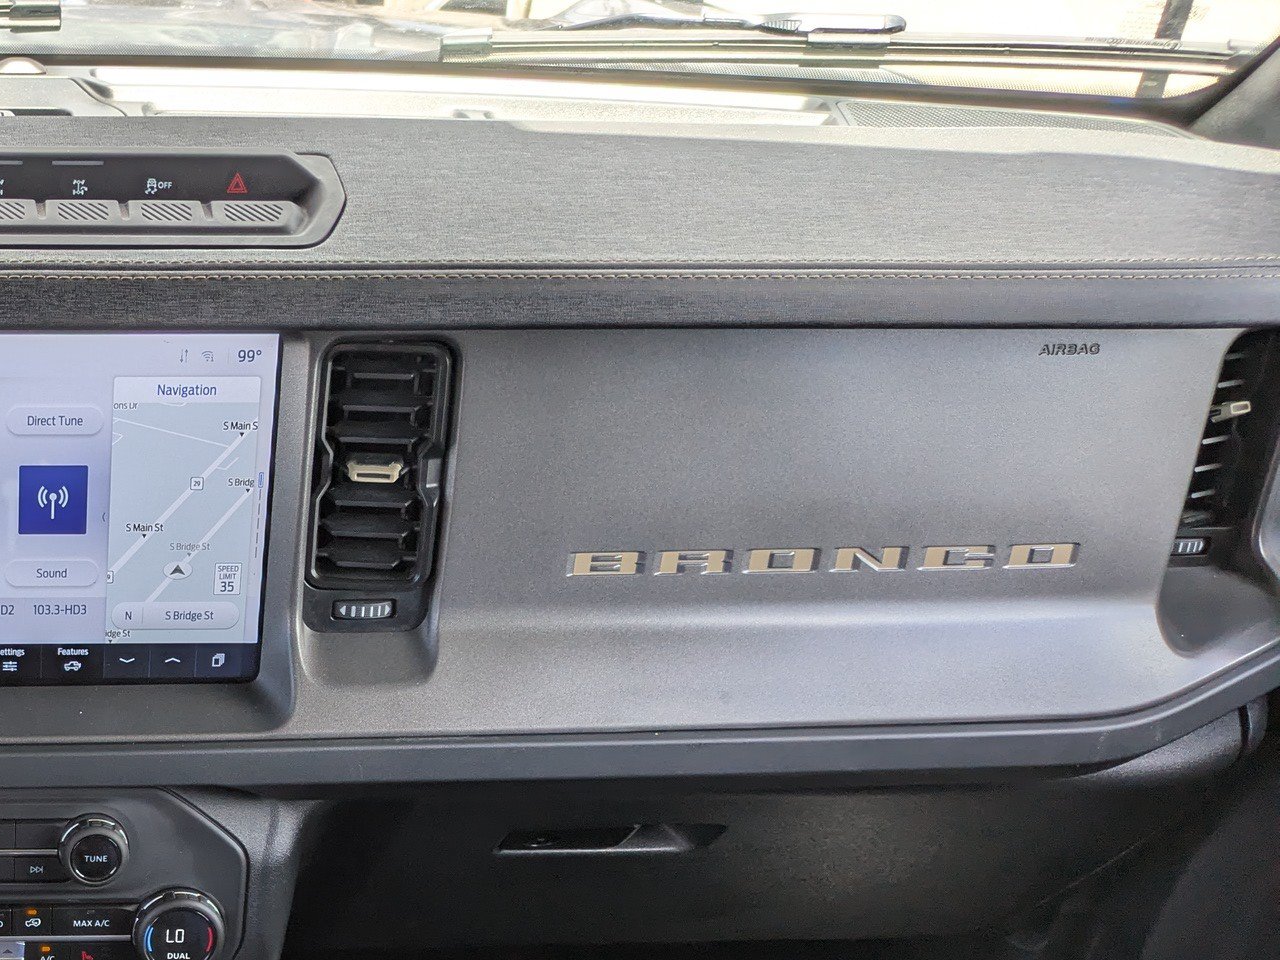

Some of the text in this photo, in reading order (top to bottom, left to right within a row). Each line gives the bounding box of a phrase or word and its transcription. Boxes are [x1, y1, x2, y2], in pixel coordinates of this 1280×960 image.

[158, 181, 172, 189] OFF
[1038, 342, 1101, 357] AIRBAG
[157, 384, 217, 398] Navigation
[27, 415, 83, 426] Direct Tune
[223, 421, 229, 430] S
[230, 421, 252, 430] Main
[228, 478, 234, 486] S
[125, 523, 164, 532] S Main St
[170, 542, 210, 552] S Bridge St
[566, 542, 1080, 577] BRONCO
[36, 568, 67, 579] Sound
[217, 565, 239, 573] SPEED
[220, 581, 235, 592] 35
[33, 604, 87, 616] 103.3-HD3
[124, 611, 132, 620] N
[165, 610, 214, 622] S Bridge St
[122, 630, 131, 638] St
[57, 647, 89, 657] Features
[84, 855, 108, 863] TUNE
[73, 919, 110, 928] MAX A/C
[166, 928, 185, 943] LO
